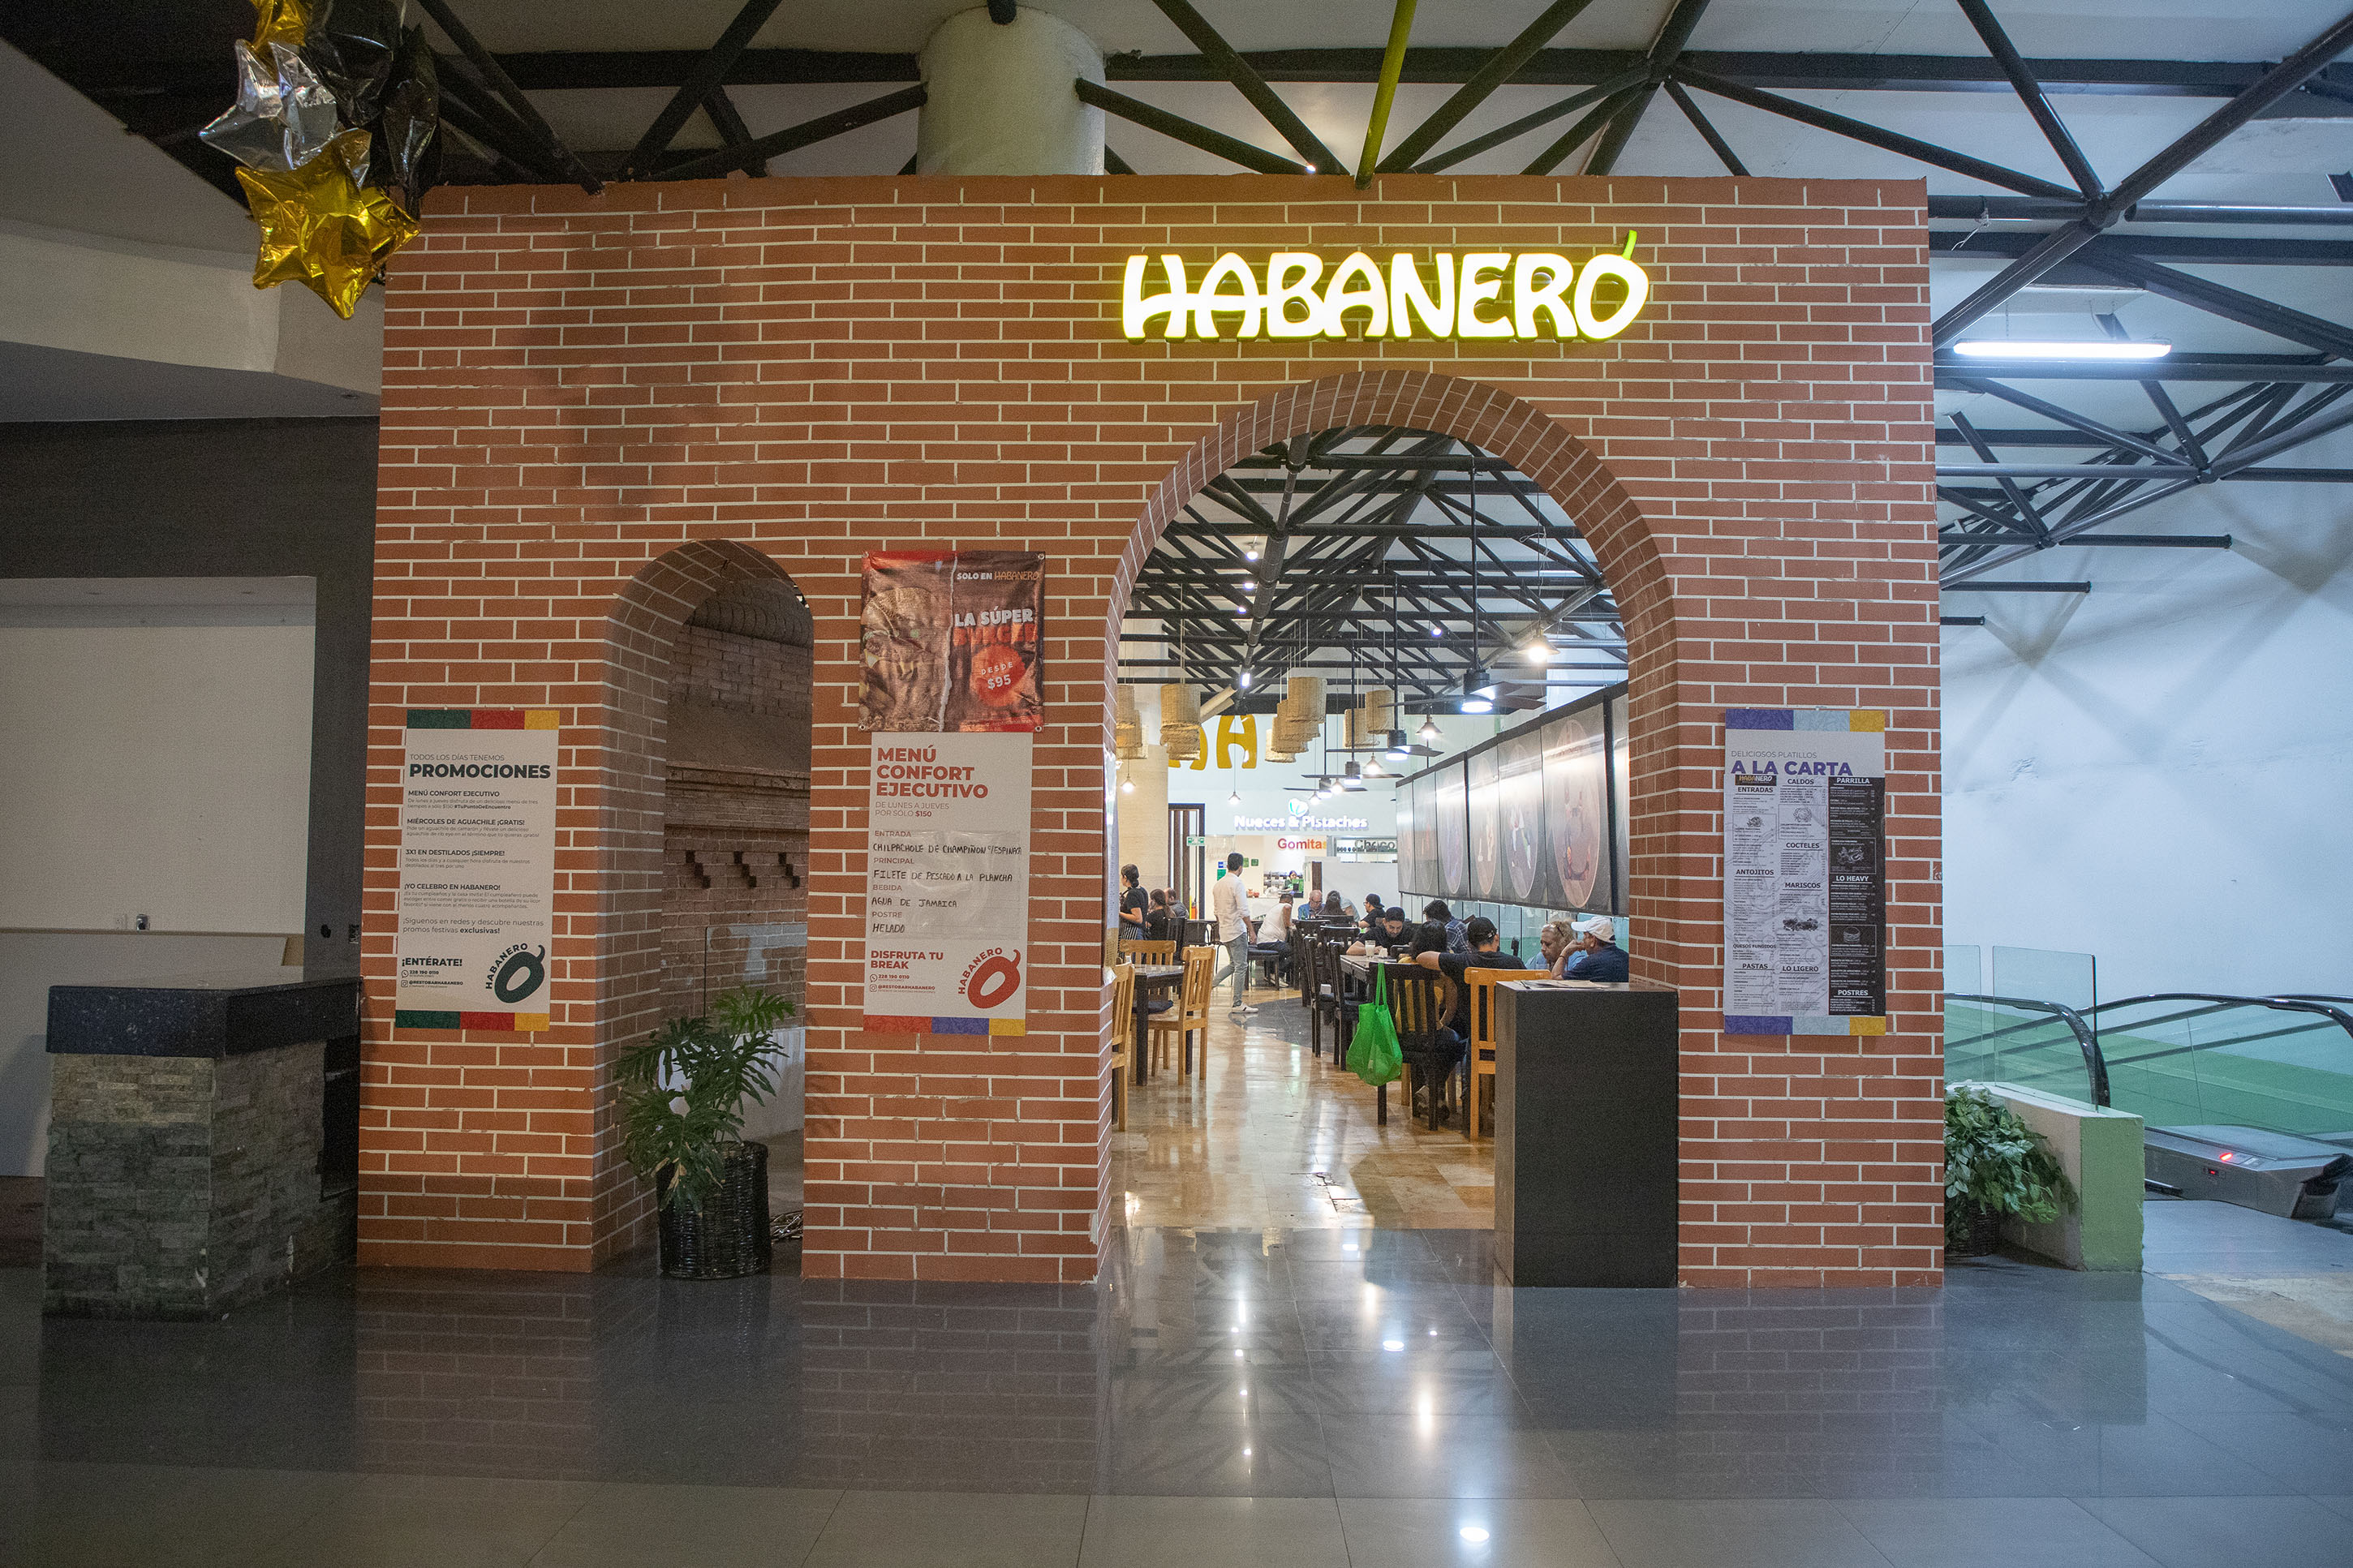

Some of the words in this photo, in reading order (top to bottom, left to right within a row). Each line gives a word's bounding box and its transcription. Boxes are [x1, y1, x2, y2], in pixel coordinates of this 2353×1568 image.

[1122, 230, 1649, 341] HABANERO
[957, 572, 979, 581] SOLO
[980, 572, 993, 581] EN
[994, 571, 1039, 581] HABANERO
[954, 613, 977, 627] LA
[980, 605, 1034, 626] SÚPER
[981, 662, 1013, 676] DESDE
[987, 675, 1012, 689] $95
[452, 753, 469, 761] DÍAS
[877, 745, 936, 763] MENÚ
[1731, 750, 1777, 758] DELICIOSOS
[1778, 751, 1817, 759] PLATILLOS
[409, 763, 551, 779] PROMOCIONES
[876, 765, 974, 780] CONFORT
[1731, 760, 1746, 775] A
[1752, 761, 1779, 775] LA
[1784, 761, 1853, 777] CARTA
[876, 782, 988, 798] EJECUTIVO
[888, 801, 913, 810] LUNES
[893, 810, 914, 818] SÓLO
[1234, 814, 1286, 829] Nueces
[1288, 816, 1299, 829] &
[1301, 814, 1369, 830] Pistaches
[928, 844, 939, 853] DE
[873, 870, 907, 879] FILETE
[911, 871, 923, 880] DE
[979, 874, 1013, 883] PLANCHA
[871, 897, 893, 905] AGUA
[900, 898, 910, 907] DE
[918, 899, 957, 909] JAMAICA
[459, 926, 500, 934] exclusivas!
[872, 923, 905, 933] HELADO
[402, 956, 462, 967] ¡ENTÉRATE!
[871, 951, 926, 960] DISFRUTA
[928, 952, 944, 960] TU
[485, 943, 527, 990] HABANERO
[871, 960, 909, 969] BREAK
[957, 947, 1003, 994] HABANERO
